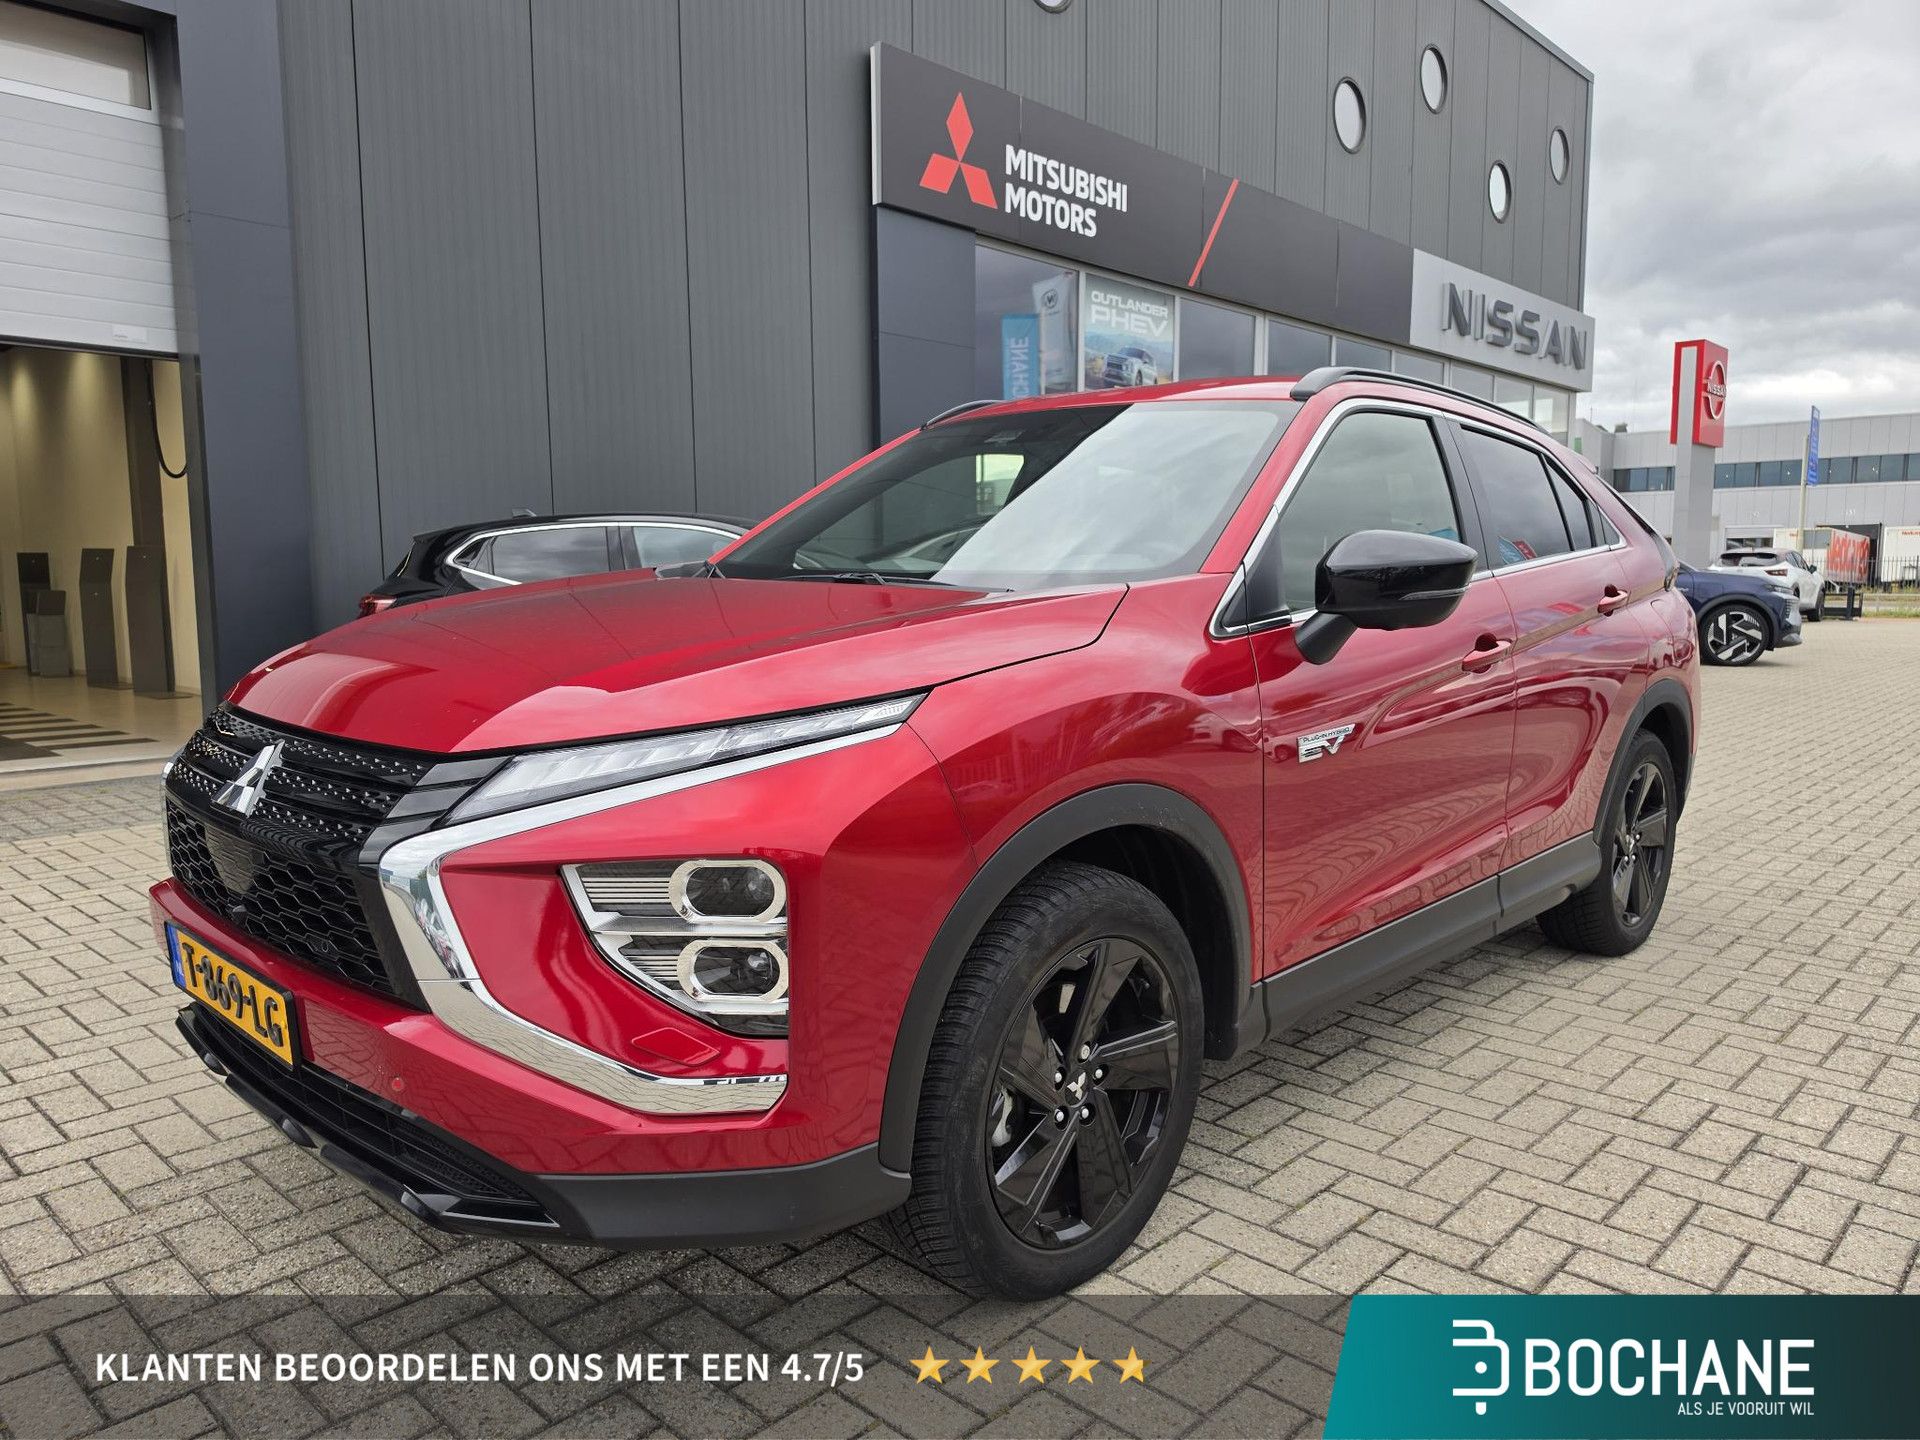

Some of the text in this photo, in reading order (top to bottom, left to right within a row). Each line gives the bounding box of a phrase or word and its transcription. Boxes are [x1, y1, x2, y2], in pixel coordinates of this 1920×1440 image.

[1005, 144, 1128, 212] MITSUBISHI
[1004, 183, 1098, 237] MOTORS
[1090, 304, 1169, 337] PHEV
[1091, 290, 1169, 319] OUTLANDER
[1441, 282, 1587, 370] NISSAN
[181, 941, 284, 1048] T-869-LG
